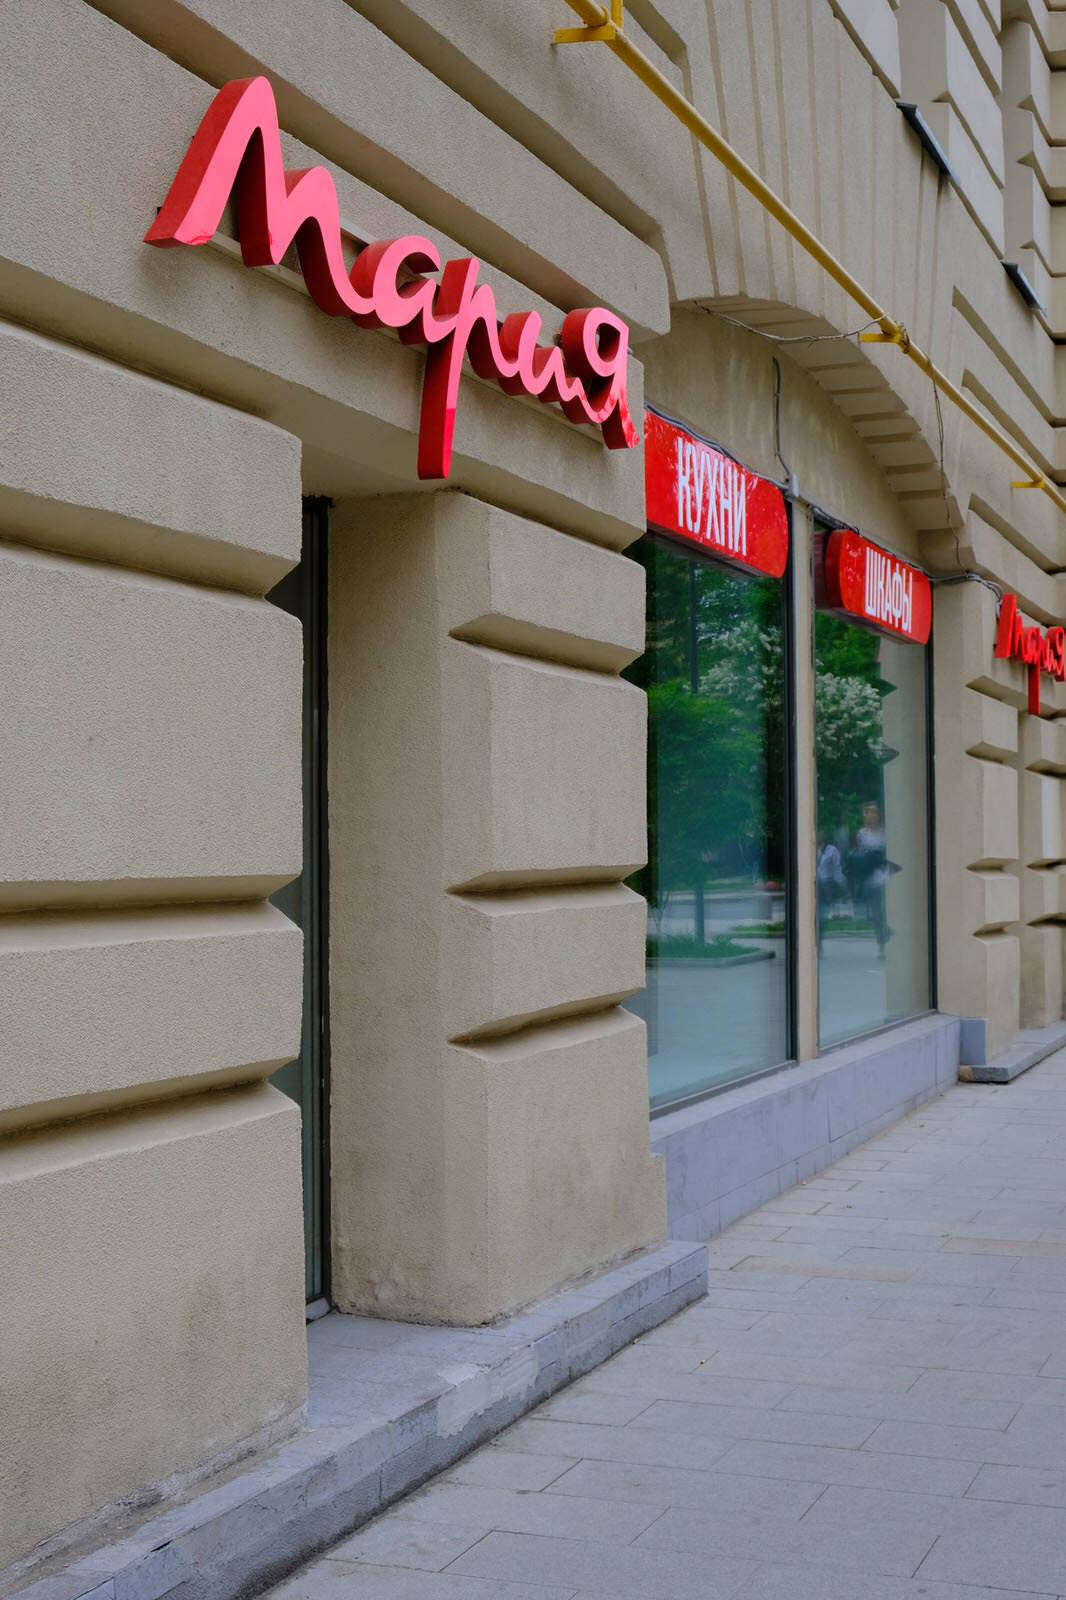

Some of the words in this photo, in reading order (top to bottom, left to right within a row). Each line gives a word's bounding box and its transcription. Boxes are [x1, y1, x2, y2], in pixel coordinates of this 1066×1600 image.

[144, 76, 640, 479] Мария
[676, 437, 748, 556] КУХНИ
[865, 547, 913, 633] ШКАФЫ
